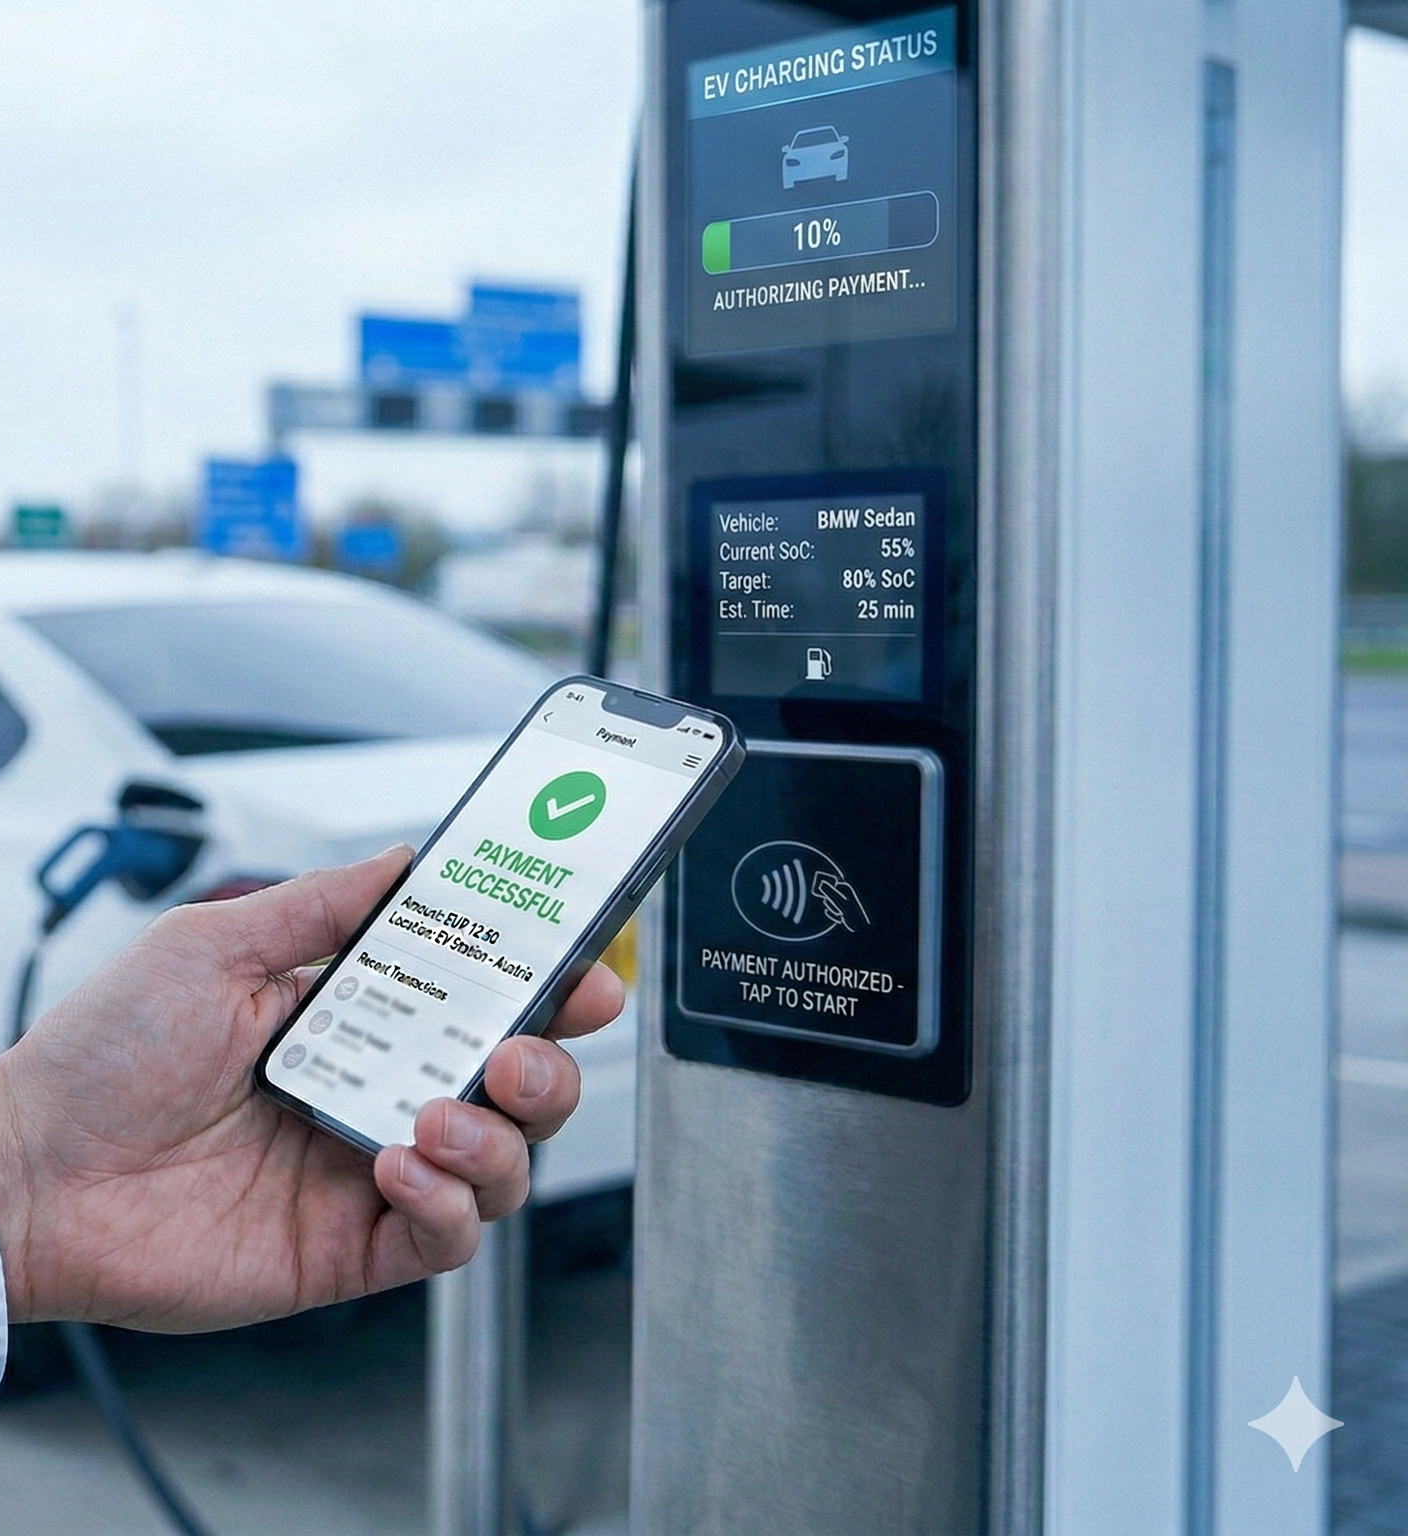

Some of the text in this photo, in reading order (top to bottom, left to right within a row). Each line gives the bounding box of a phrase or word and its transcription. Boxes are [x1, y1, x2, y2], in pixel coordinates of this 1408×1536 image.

[704, 30, 937, 99] EV CHARGING STATUS
[794, 218, 841, 250] 10%
[713, 269, 926, 311] AUTHORIZING PAYMENT...
[719, 507, 915, 532] Vehicle: BMW Sedan
[719, 538, 915, 561] Current SoC: 55%
[719, 569, 915, 594] Target: 80% SoC
[719, 600, 914, 618] Est. Time: 25 min
[473, 839, 574, 890] PAYMENT
[440, 859, 565, 925] SUCCESSFUL
[435, 930, 454, 946] EV
[702, 949, 778, 976] PAYMENT
[781, 960, 893, 993] AUTHORIZED
[739, 981, 859, 1017] TAP TO START
